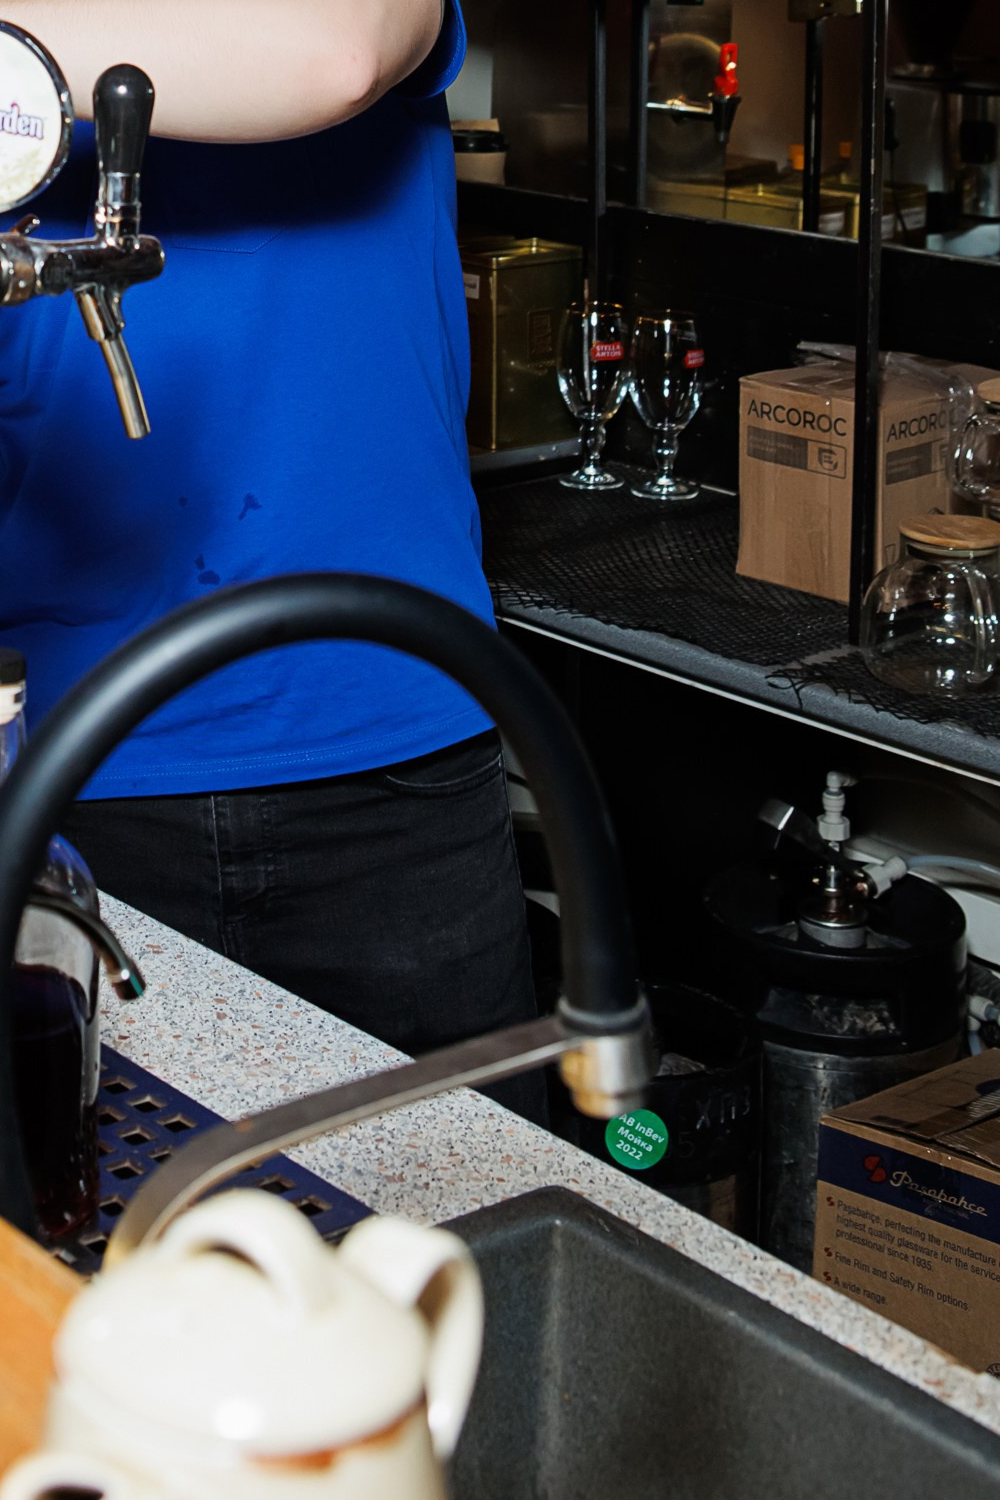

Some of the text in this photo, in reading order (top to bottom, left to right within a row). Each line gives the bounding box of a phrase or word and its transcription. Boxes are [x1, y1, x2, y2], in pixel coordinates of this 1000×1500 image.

[747, 399, 847, 437] ARCOROC
[617, 1126, 654, 1153] Мойка
[618, 1113, 665, 1144] AB InBev
[615, 1139, 644, 1161] 2022
[835, 1228, 934, 1272] professional since 1935.
[836, 1214, 867, 1233] highest
[868, 1225, 895, 1244] quality
[897, 1237, 938, 1259] glassware
[940, 1250, 953, 1263] for
[954, 1257, 968, 1270] the
[884, 1217, 926, 1241] perfecting
[927, 1233, 941, 1246] the
[943, 1241, 996, 1267] manufacture
[833, 1276, 888, 1306] A wide range.
[834, 1252, 970, 1312] Fine Rim and Safety Rim options.
